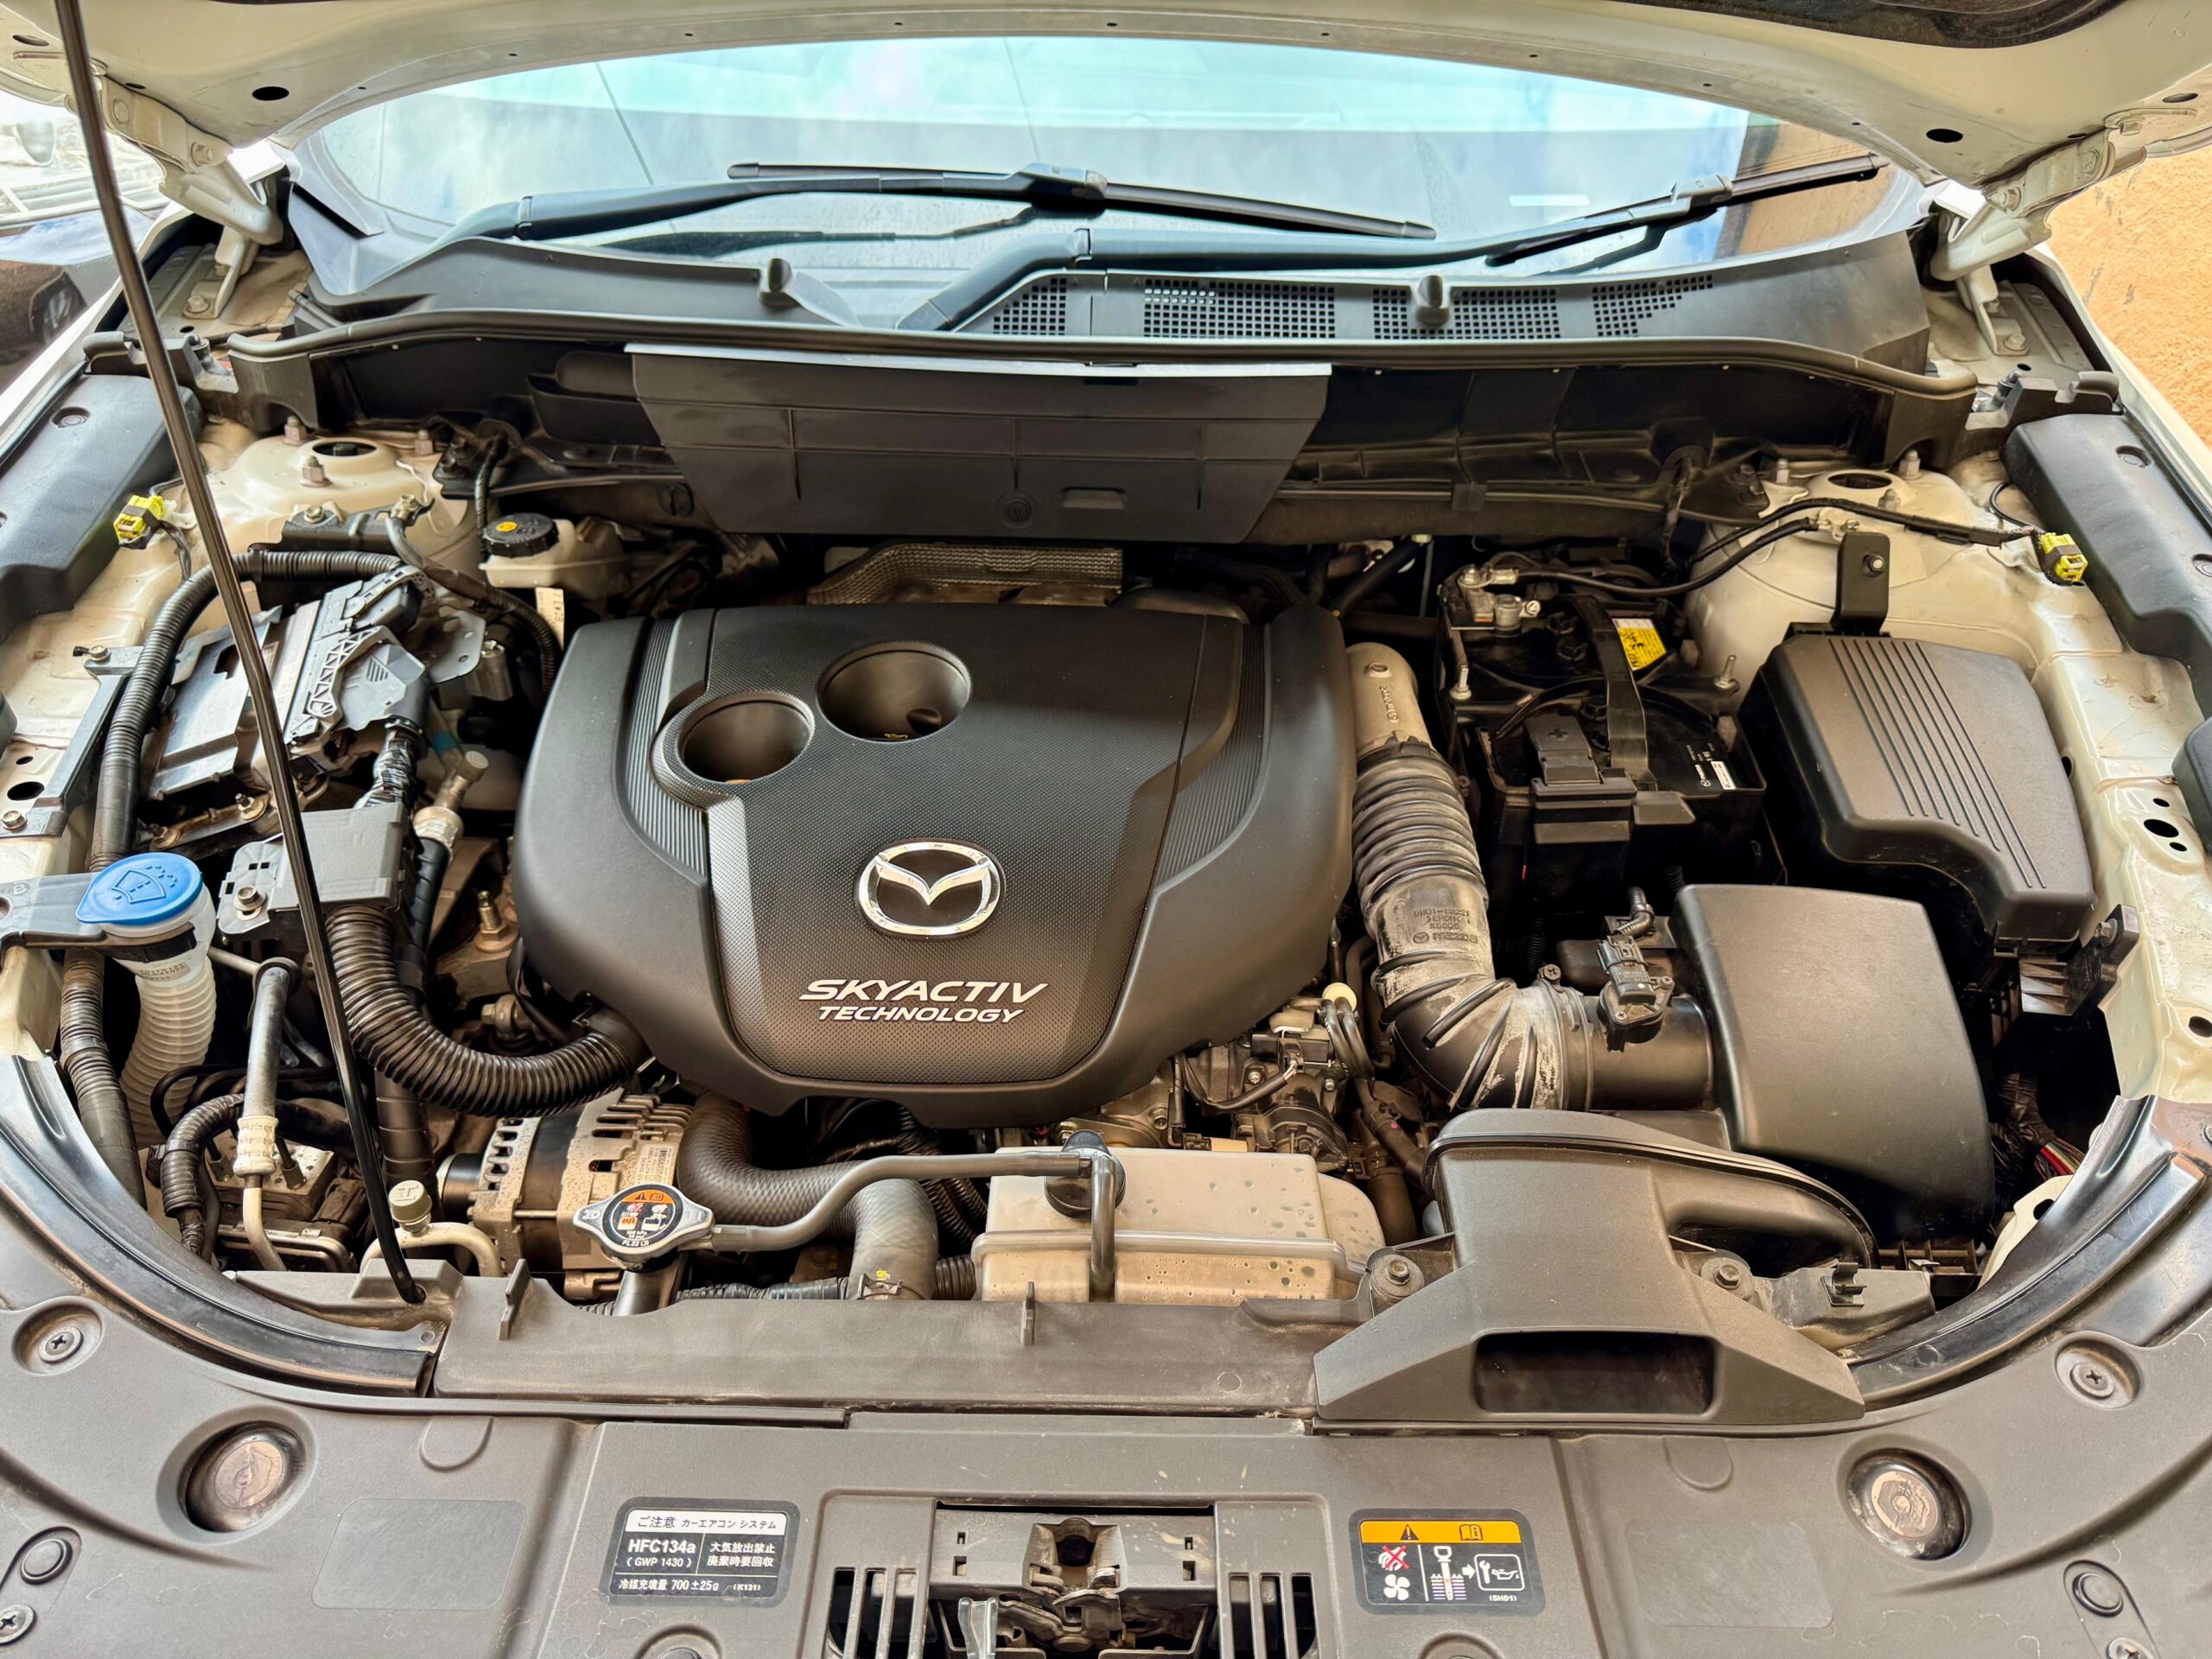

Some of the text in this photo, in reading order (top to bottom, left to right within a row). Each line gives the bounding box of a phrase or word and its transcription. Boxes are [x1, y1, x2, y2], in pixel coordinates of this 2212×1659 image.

[798, 979, 1049, 1003] SKYACTIV
[819, 1006, 1024, 1023] TECHNOLOGY
[638, 1516, 777, 1529] ご注意 カーエアコン システム
[627, 1538, 696, 1554] HFC134a
[709, 1541, 776, 1554] 大気放出禁止
[707, 1554, 774, 1567] 廃棄時要回収
